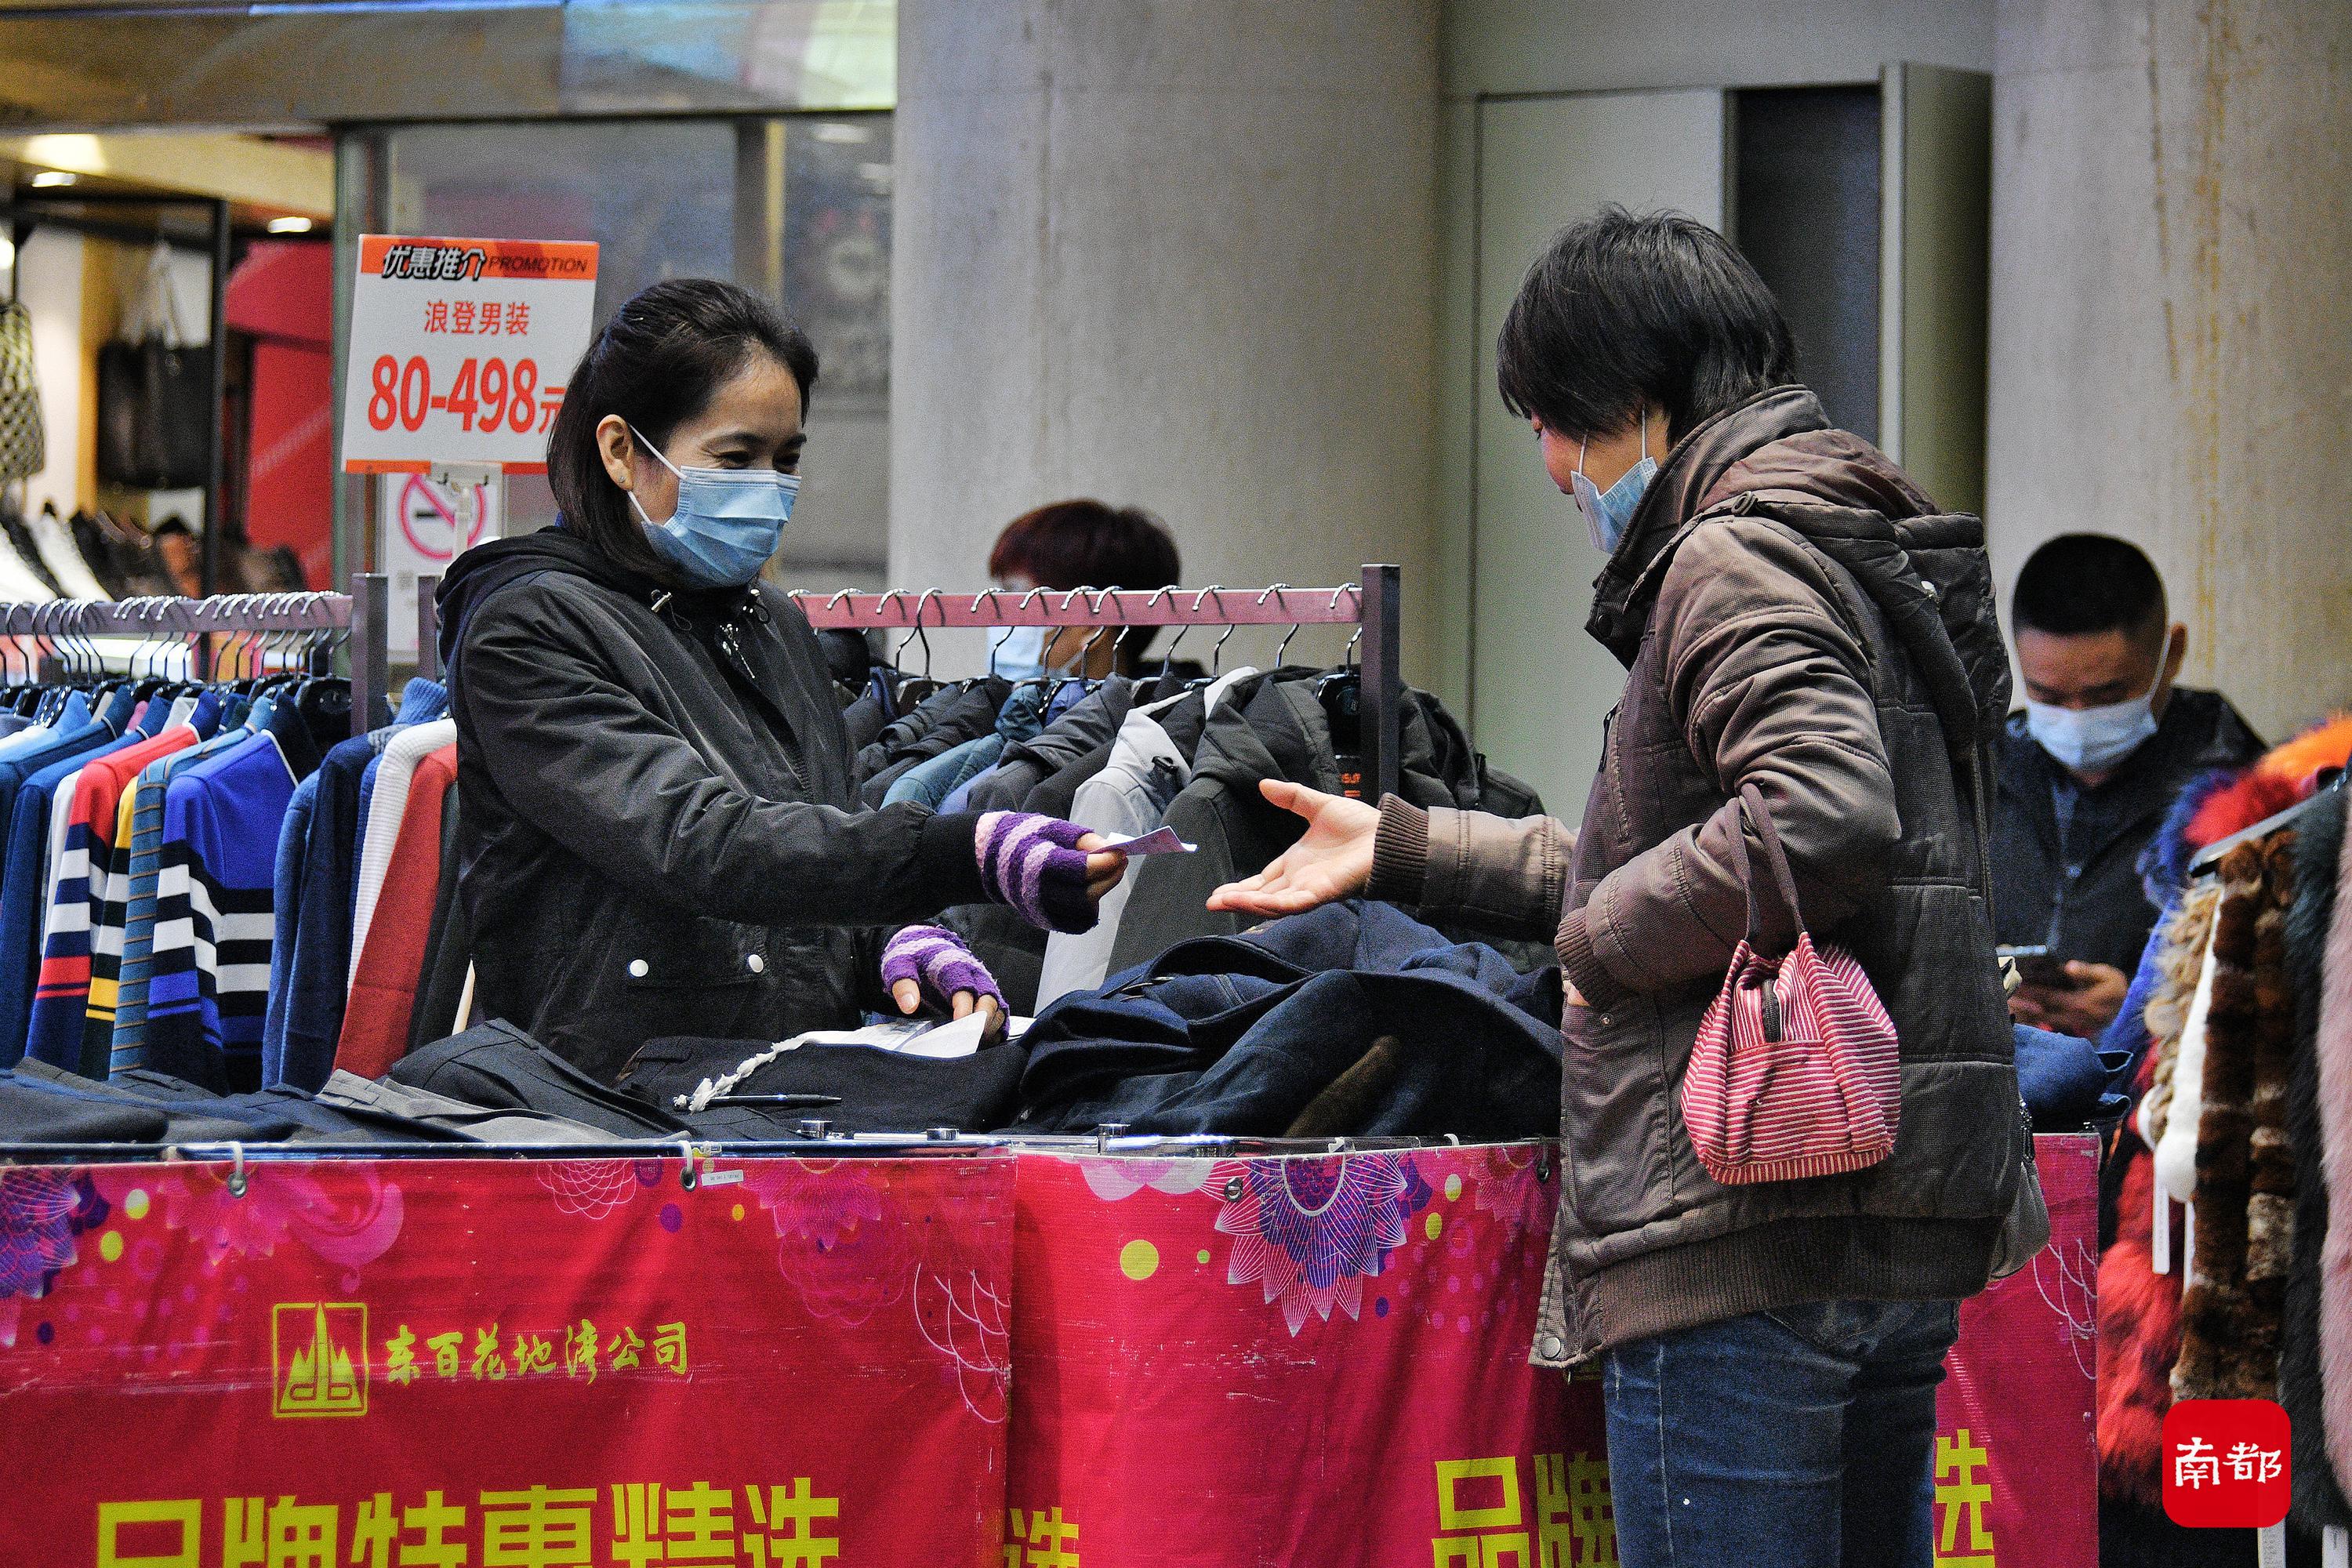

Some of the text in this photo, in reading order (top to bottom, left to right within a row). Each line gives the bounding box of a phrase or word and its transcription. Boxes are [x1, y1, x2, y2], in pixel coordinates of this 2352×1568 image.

[383, 245, 587, 281] 优惠推介 PROMOTION
[424, 301, 530, 336] 浪登男装
